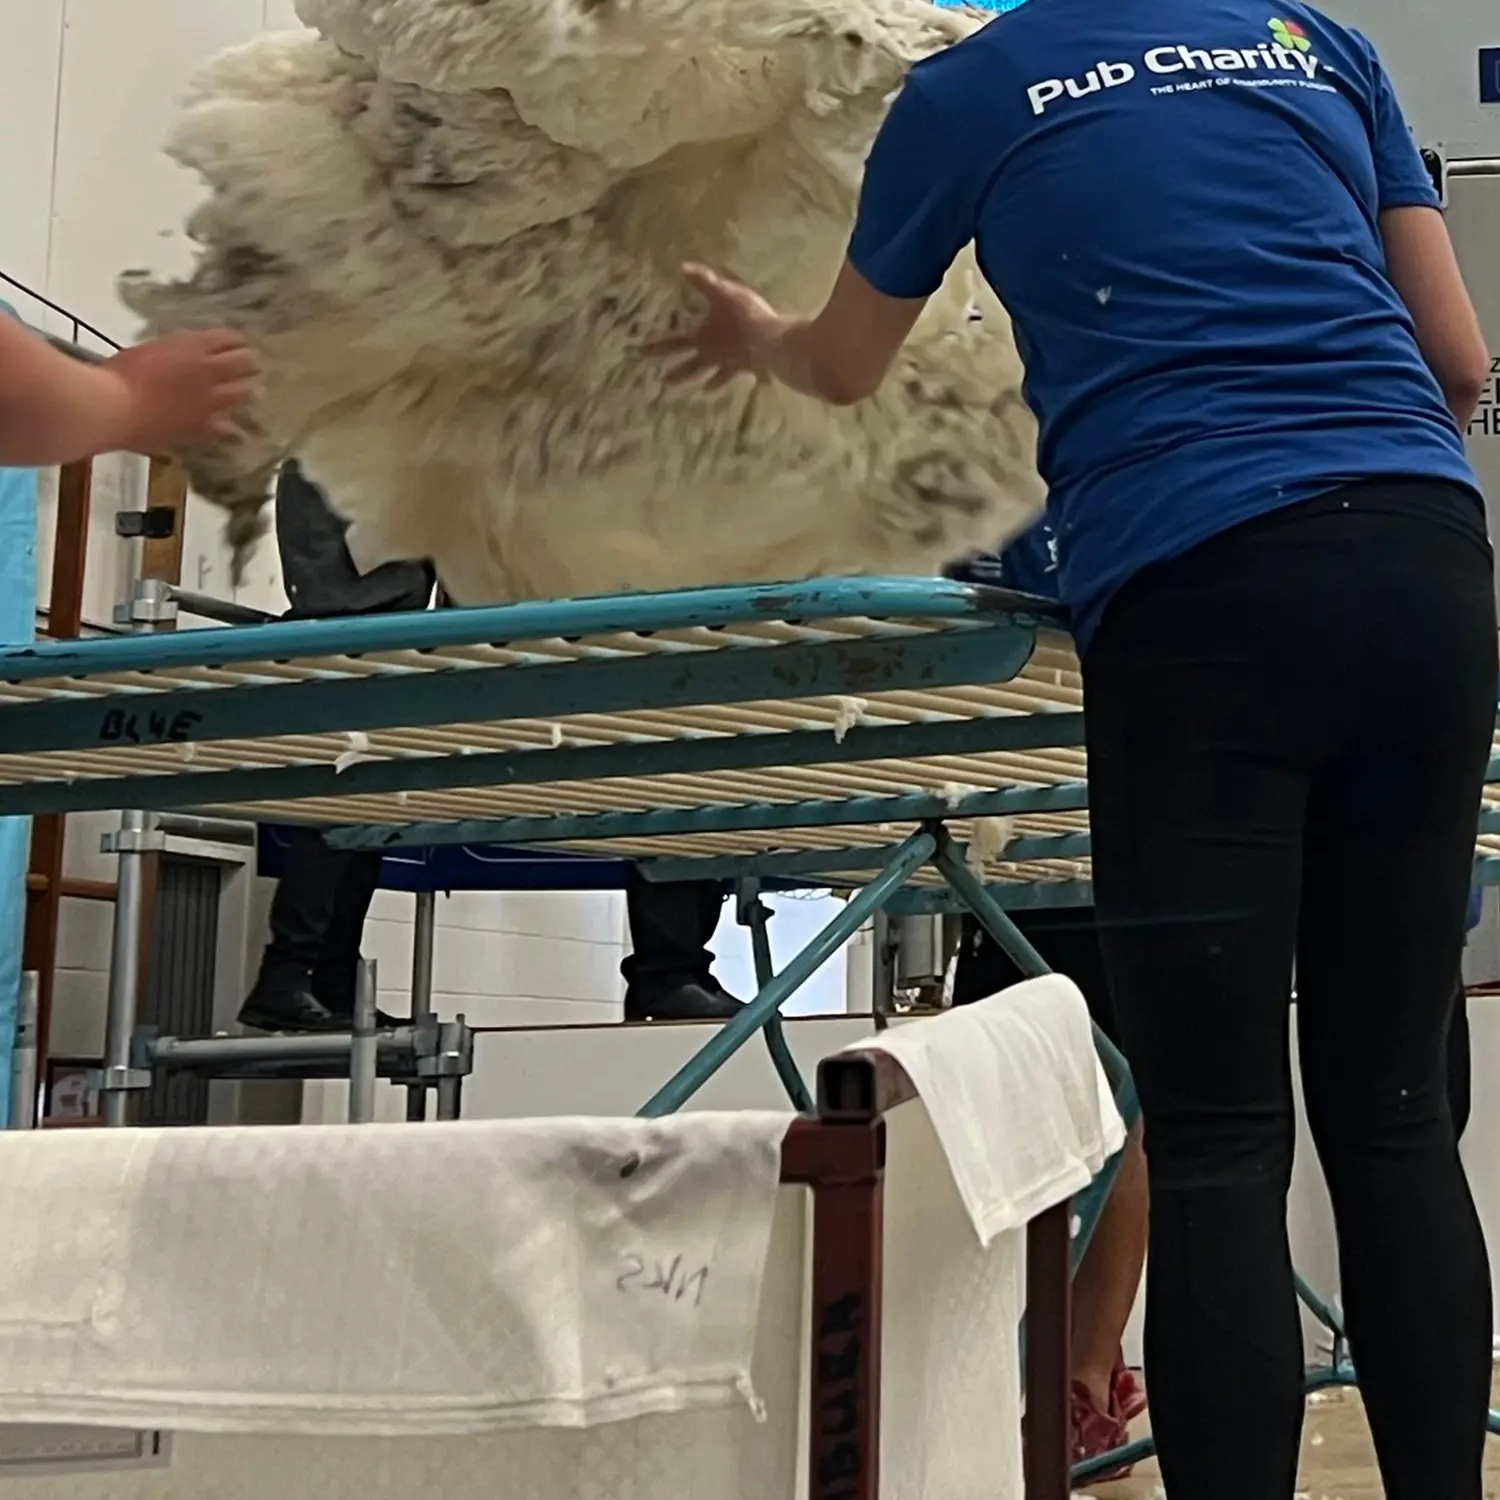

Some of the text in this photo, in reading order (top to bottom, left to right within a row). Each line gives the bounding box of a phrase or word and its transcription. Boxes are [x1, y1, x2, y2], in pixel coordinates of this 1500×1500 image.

[1027, 43, 1318, 115] Pub Charity
[1176, 79, 1213, 92] HEART
